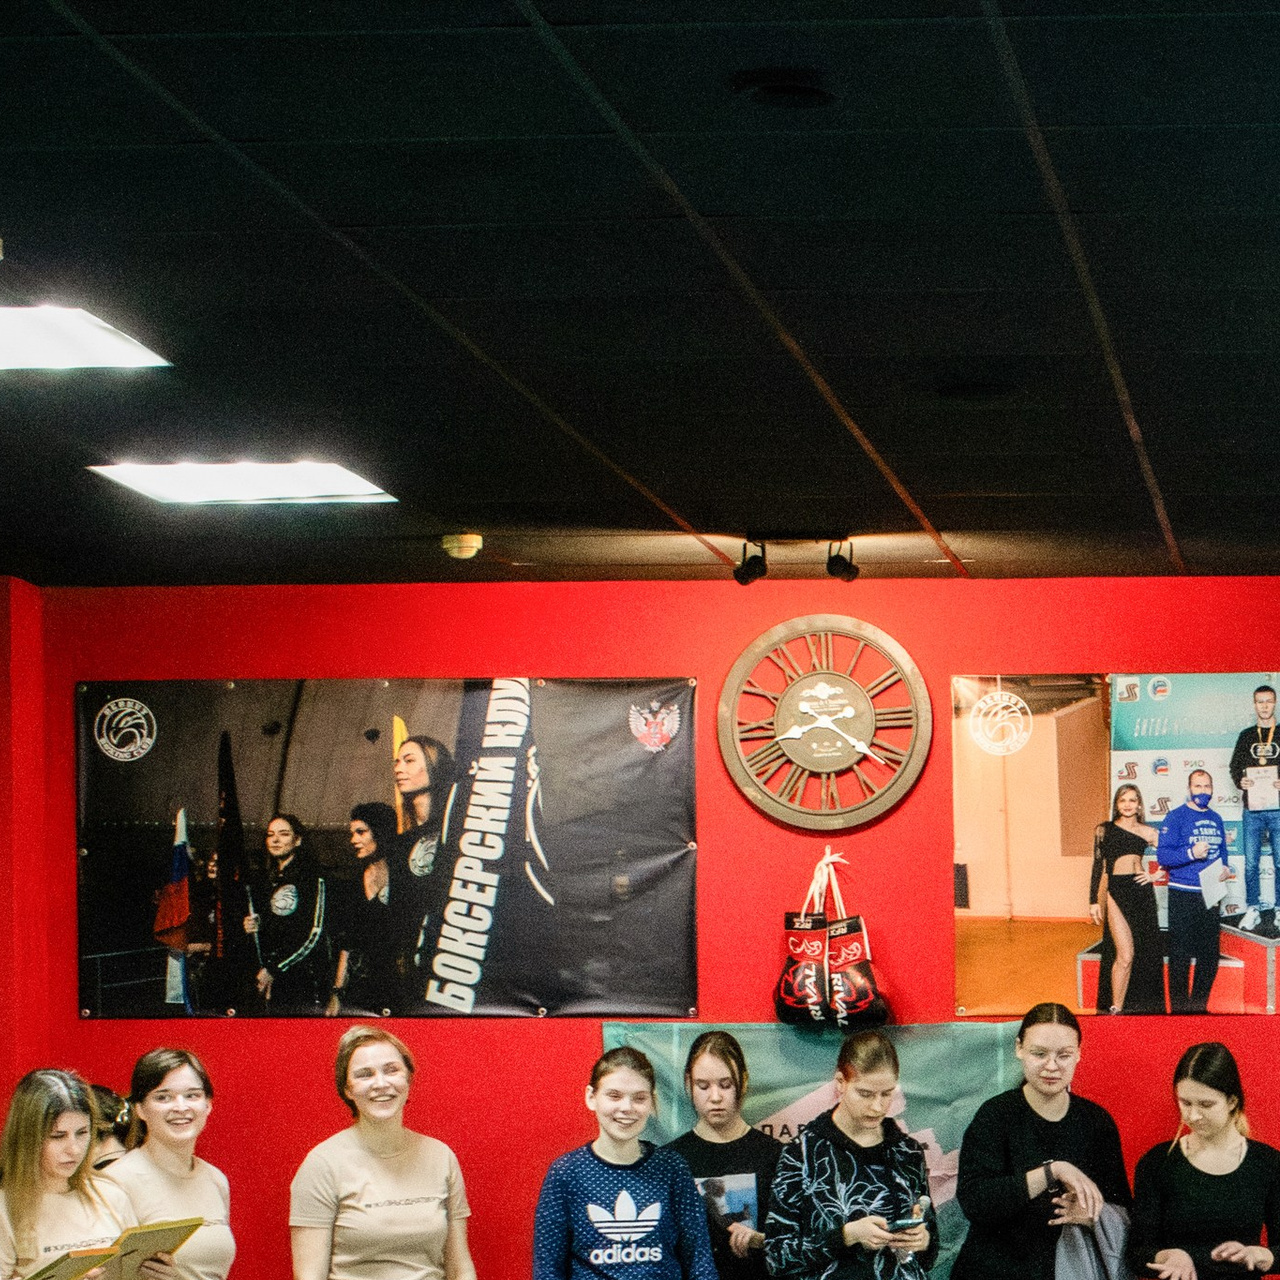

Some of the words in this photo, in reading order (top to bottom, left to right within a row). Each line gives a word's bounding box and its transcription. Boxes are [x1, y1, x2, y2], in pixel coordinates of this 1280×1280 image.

[425, 756, 517, 1015] БОКСЕРСКИЙ
[482, 678, 530, 749] КЛУ
[804, 963, 826, 1021] RIVAL
[830, 973, 849, 1027] RIVAL
[590, 1243, 663, 1265] adidas
